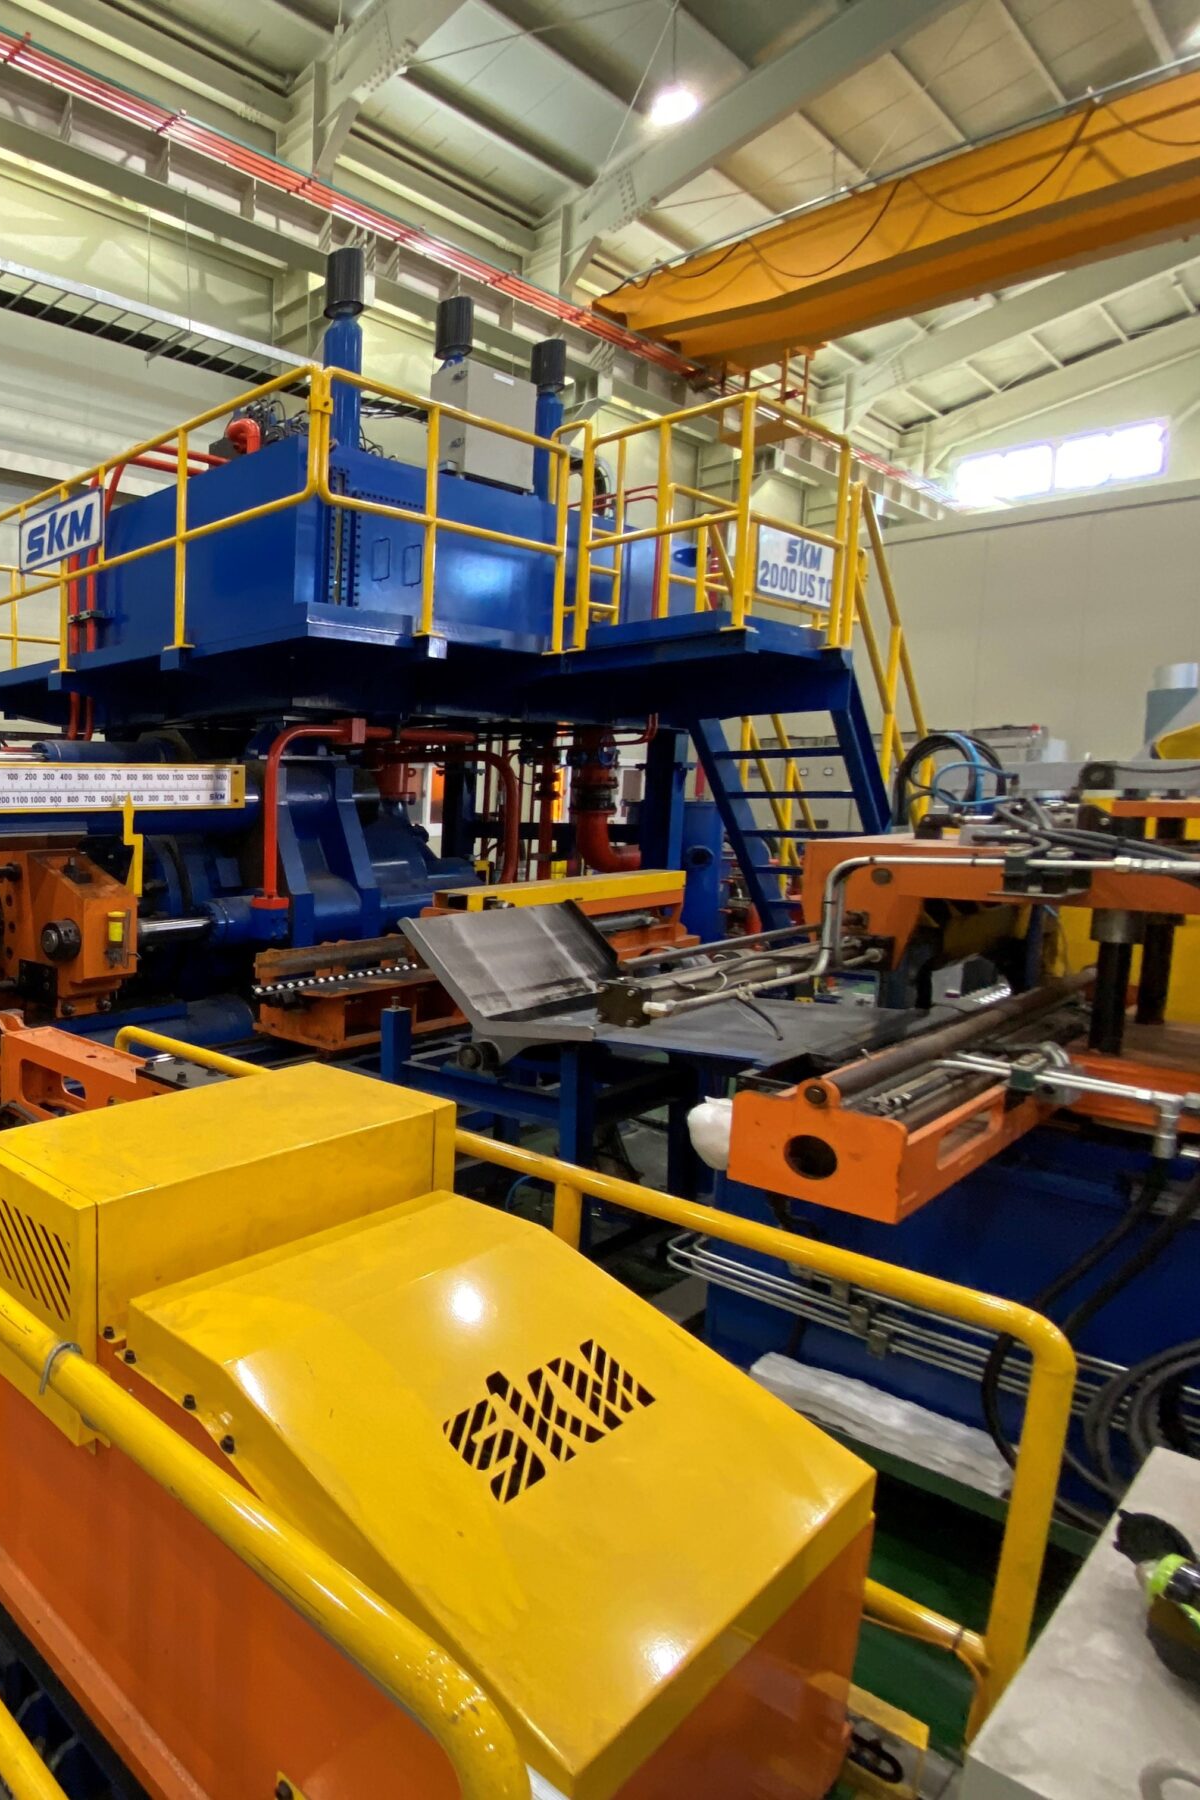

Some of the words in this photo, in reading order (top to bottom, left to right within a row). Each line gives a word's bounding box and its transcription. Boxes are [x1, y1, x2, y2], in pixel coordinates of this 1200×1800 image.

[26, 502, 94, 564] SKM
[786, 537, 822, 571] SKM
[49, 795, 62, 803] 900
[67, 795, 79, 803] 800
[148, 794, 159, 802] 300
[209, 792, 226, 800] SKM
[442, 1338, 656, 1504] SKM
